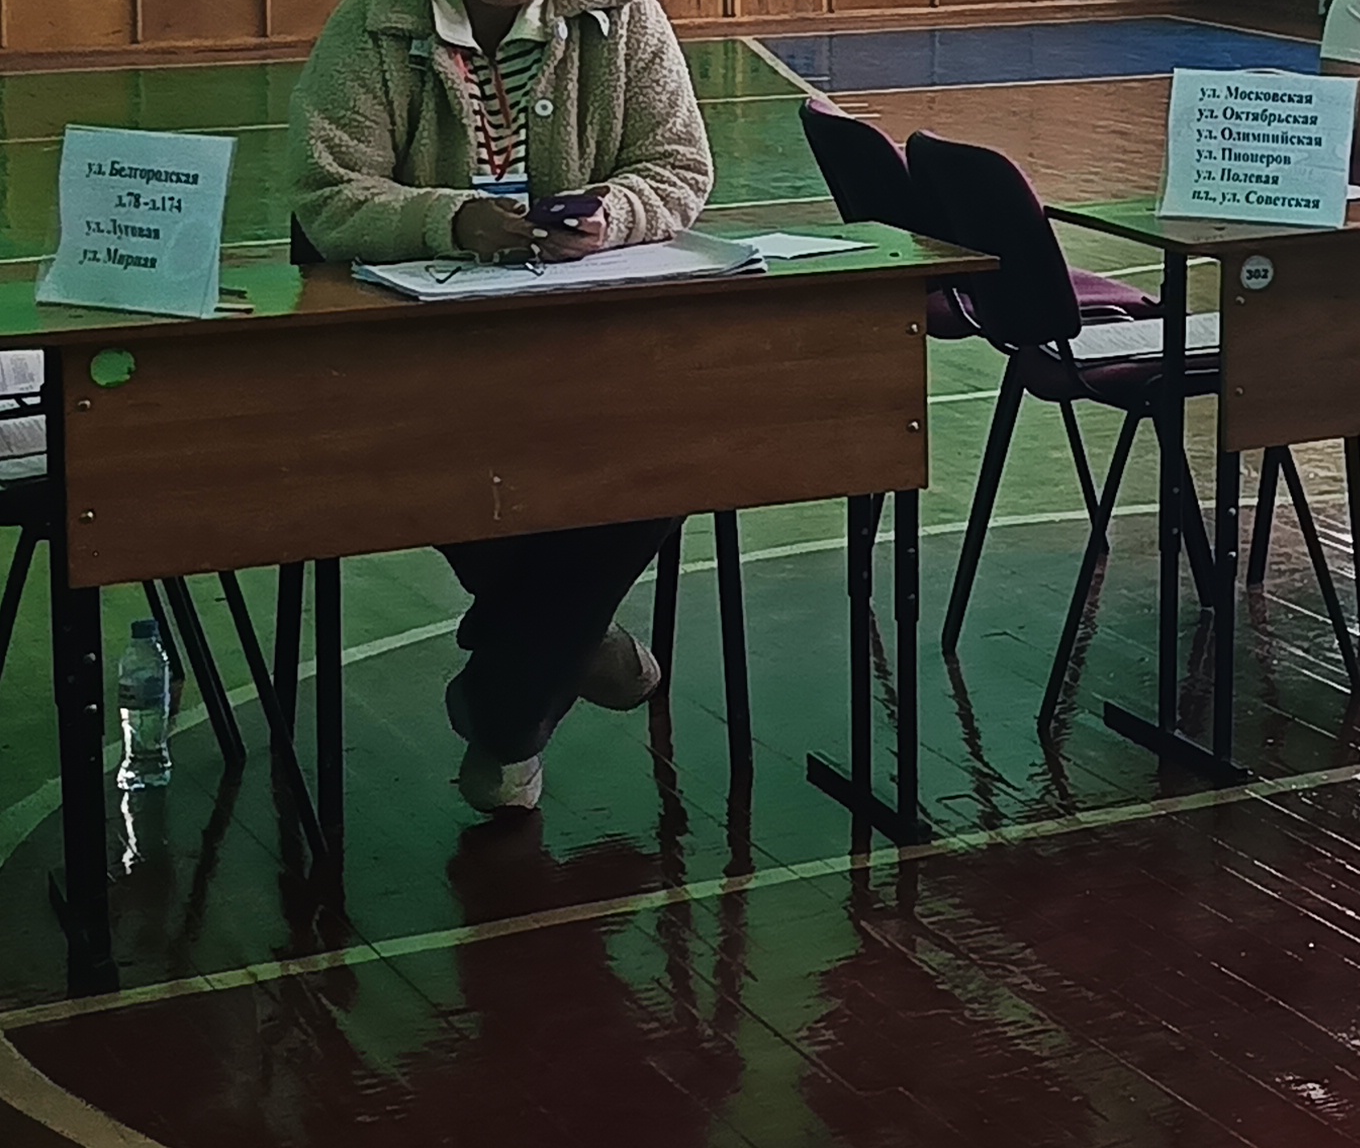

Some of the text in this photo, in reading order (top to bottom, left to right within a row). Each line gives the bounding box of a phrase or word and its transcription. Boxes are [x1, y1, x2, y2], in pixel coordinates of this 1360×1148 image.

[1199, 86, 1313, 104] ул. Московская
[1196, 106, 1318, 126] ул. Октябрьская
[1196, 128, 1322, 147] ул. Олимпийская
[1195, 148, 1292, 167] ул. Пионеров
[85, 160, 199, 185] ул. Белгородская
[1194, 168, 1280, 185] ул. Полевая
[1219, 192, 1241, 205] ул.
[1245, 191, 1321, 209] Советская
[85, 218, 161, 239] ул. Луговая
[78, 247, 157, 270] ул. Мирная
[1246, 268, 1269, 280] 302
